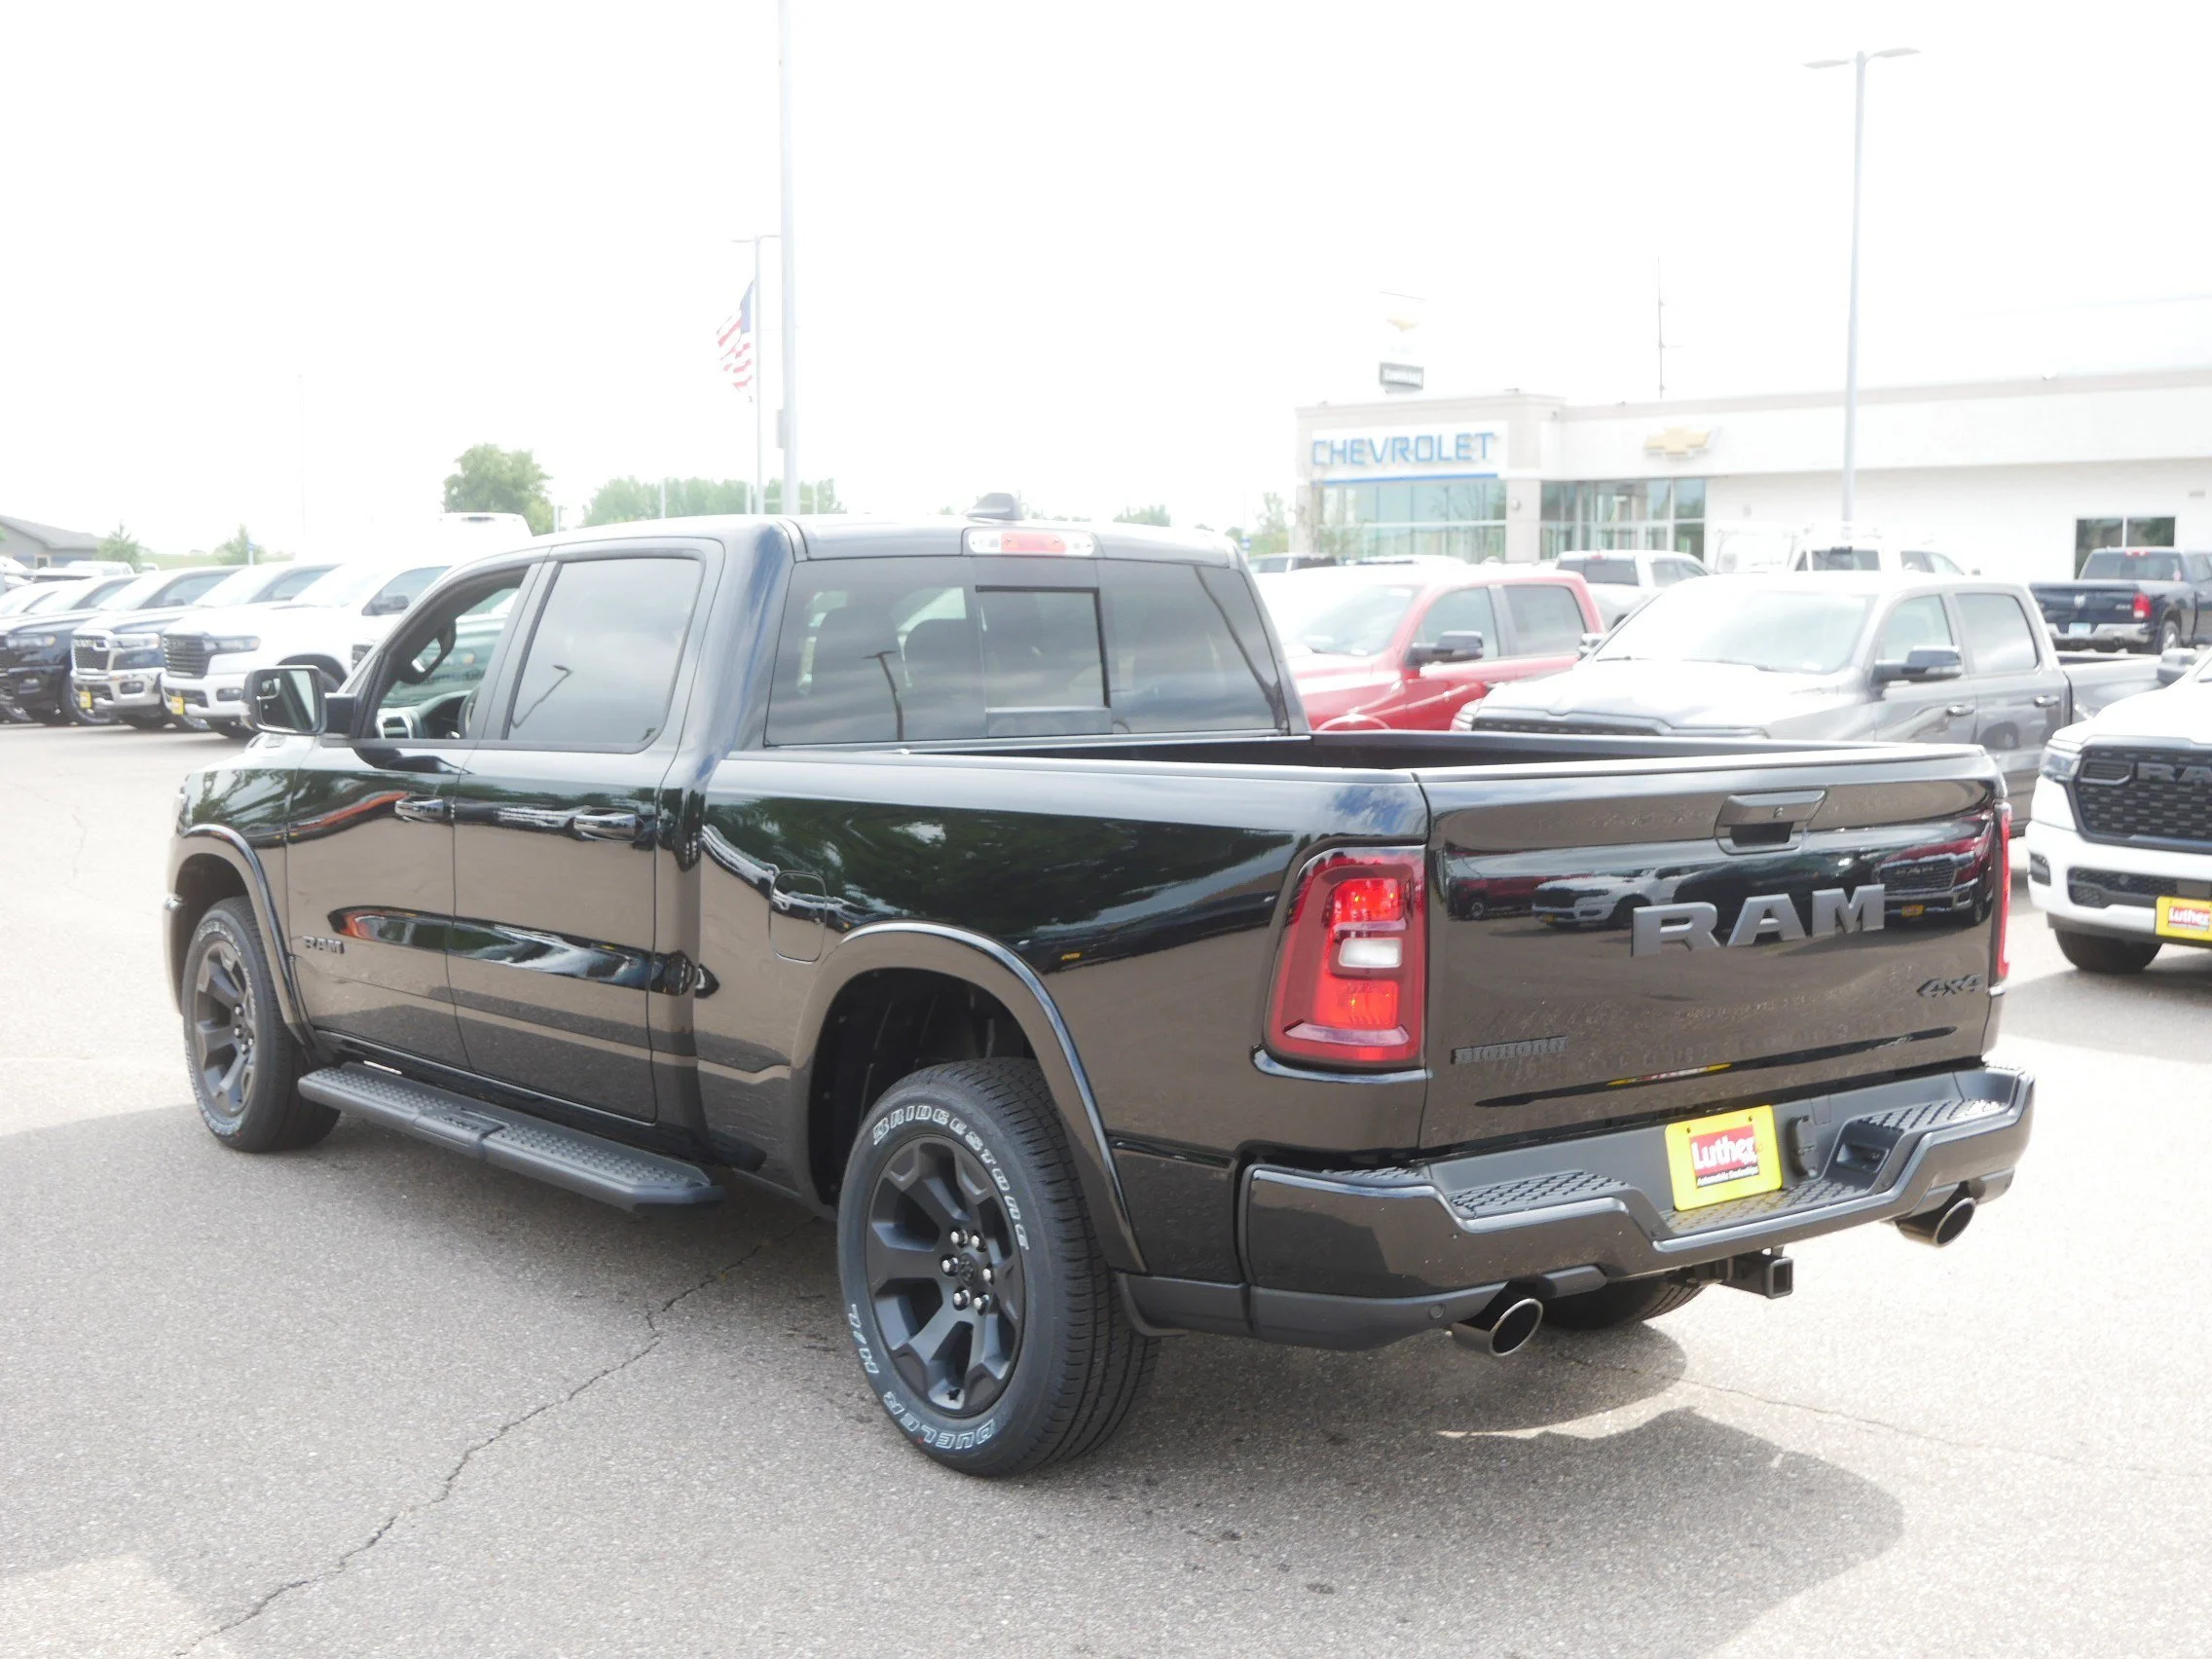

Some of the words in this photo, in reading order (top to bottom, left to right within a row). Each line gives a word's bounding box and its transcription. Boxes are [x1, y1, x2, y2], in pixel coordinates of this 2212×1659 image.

[1311, 431, 1494, 466] CHEVROLET
[1630, 883, 1886, 957] RAM
[303, 936, 345, 954] RAM
[1692, 1135, 1758, 1169] Luther
[872, 1105, 1030, 1250] BRIDGESTONE
[883, 1390, 997, 1450] DUELER
